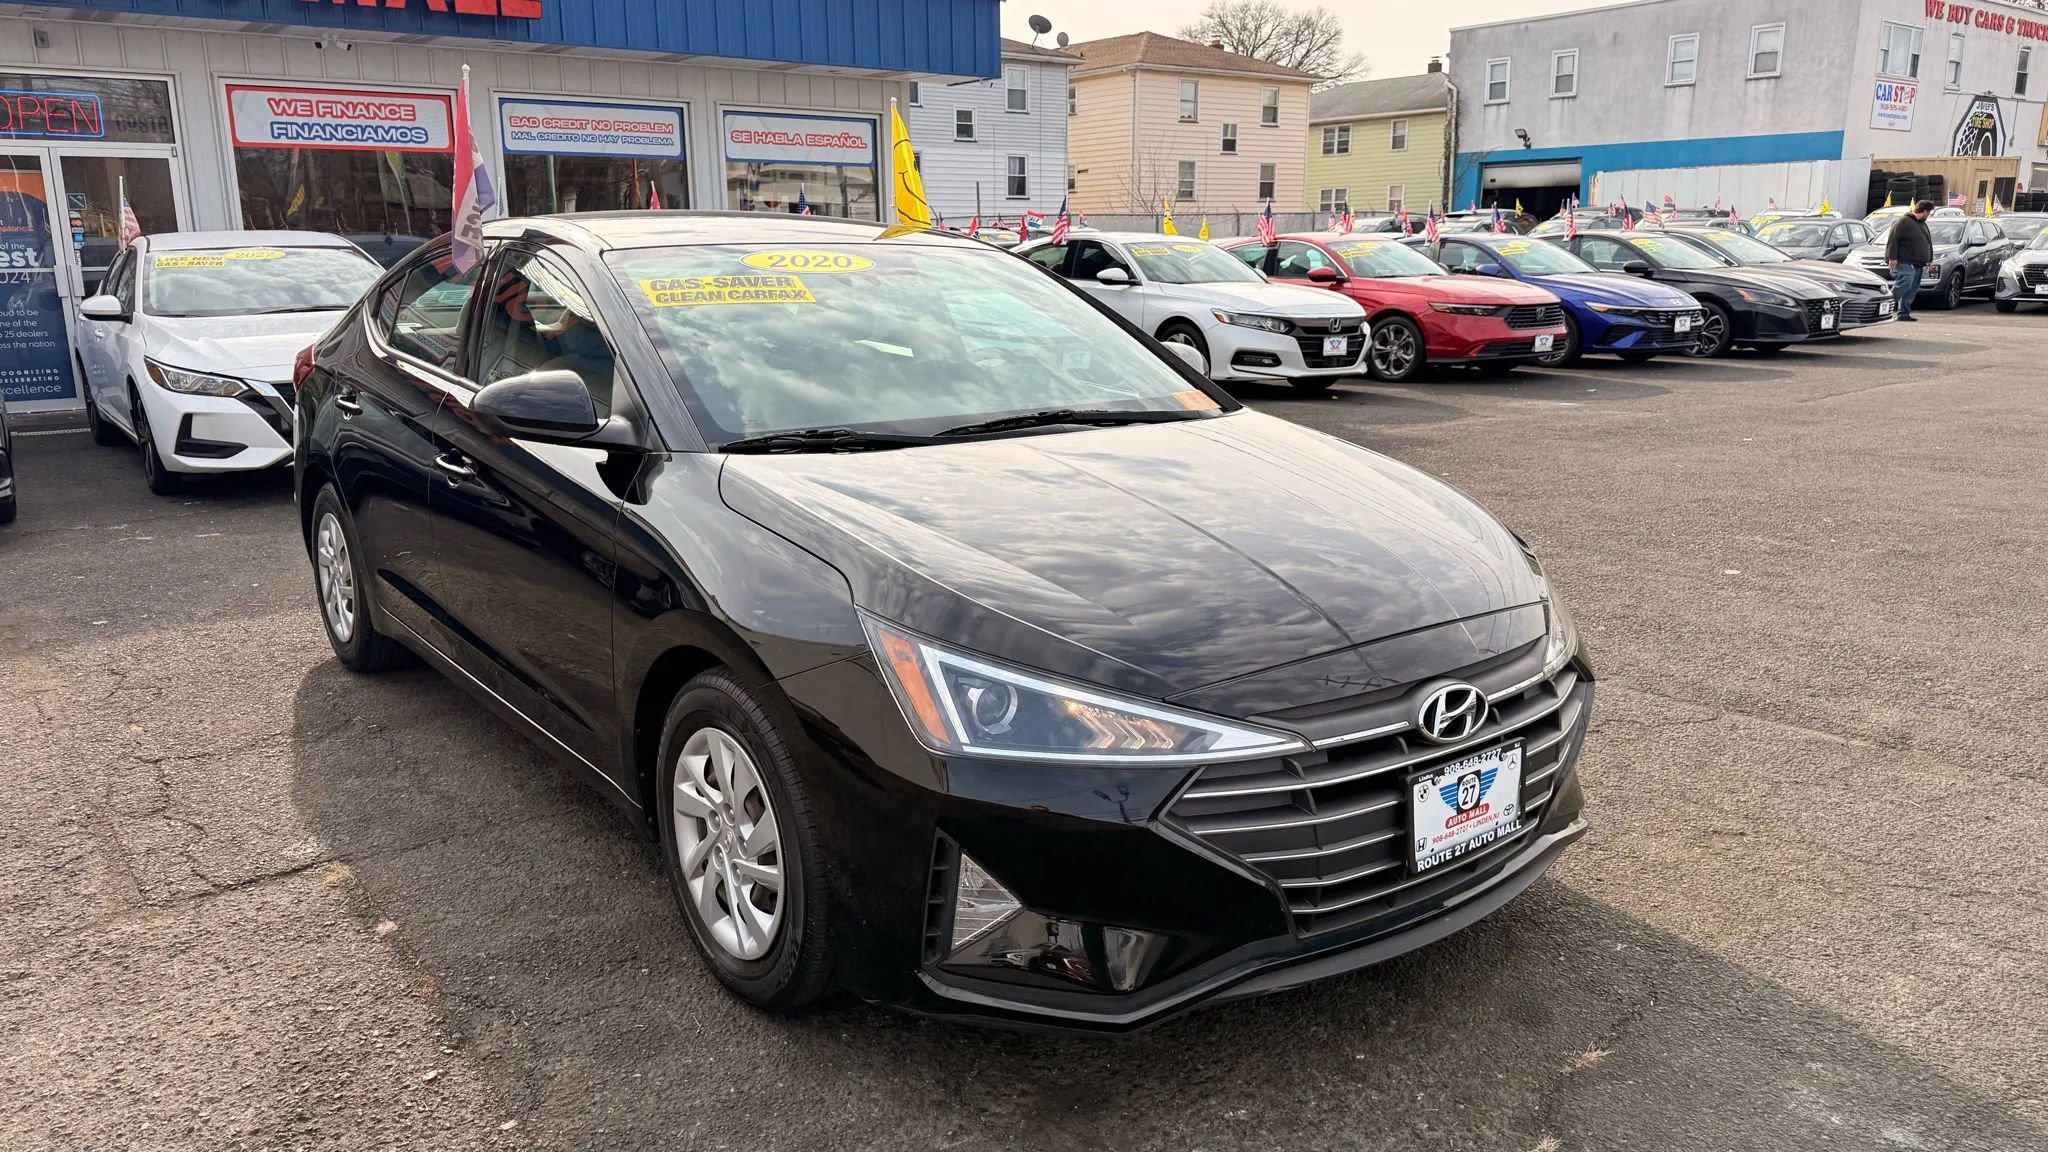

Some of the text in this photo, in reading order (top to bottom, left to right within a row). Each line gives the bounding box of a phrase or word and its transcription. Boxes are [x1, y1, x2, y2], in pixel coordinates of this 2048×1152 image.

[1925, 0, 1945, 20] WE
[1946, 4, 1974, 25] BUY
[1974, 9, 2006, 32] CARS
[1876, 83, 1893, 102] CAR
[267, 98, 416, 121] WE FINANCE
[270, 121, 428, 144] FINANCIAMOS
[509, 116, 674, 134] BAD CREDIT NO PROBLEM
[511, 131, 674, 146] MAL CREDITO NO HAY PROBLEMA
[731, 130, 867, 149] SE HABLA ESPAÑOL
[11, 242, 25, 250] the
[768, 254, 852, 268] 2020
[650, 276, 796, 291] GAS-SAVER
[655, 288, 808, 303] CLEAN CARFAX
[12, 319, 21, 327] of
[23, 319, 38, 327] the
[4, 330, 15, 338] 25
[16, 330, 49, 338] dealers
[13, 341, 27, 349] the
[1462, 776, 1477, 787] ROUTE
[1461, 784, 1476, 806] 27
[1447, 805, 1487, 828] AUTO MALL
[1417, 820, 1522, 873] ROUTE 27 AUTO MALL
